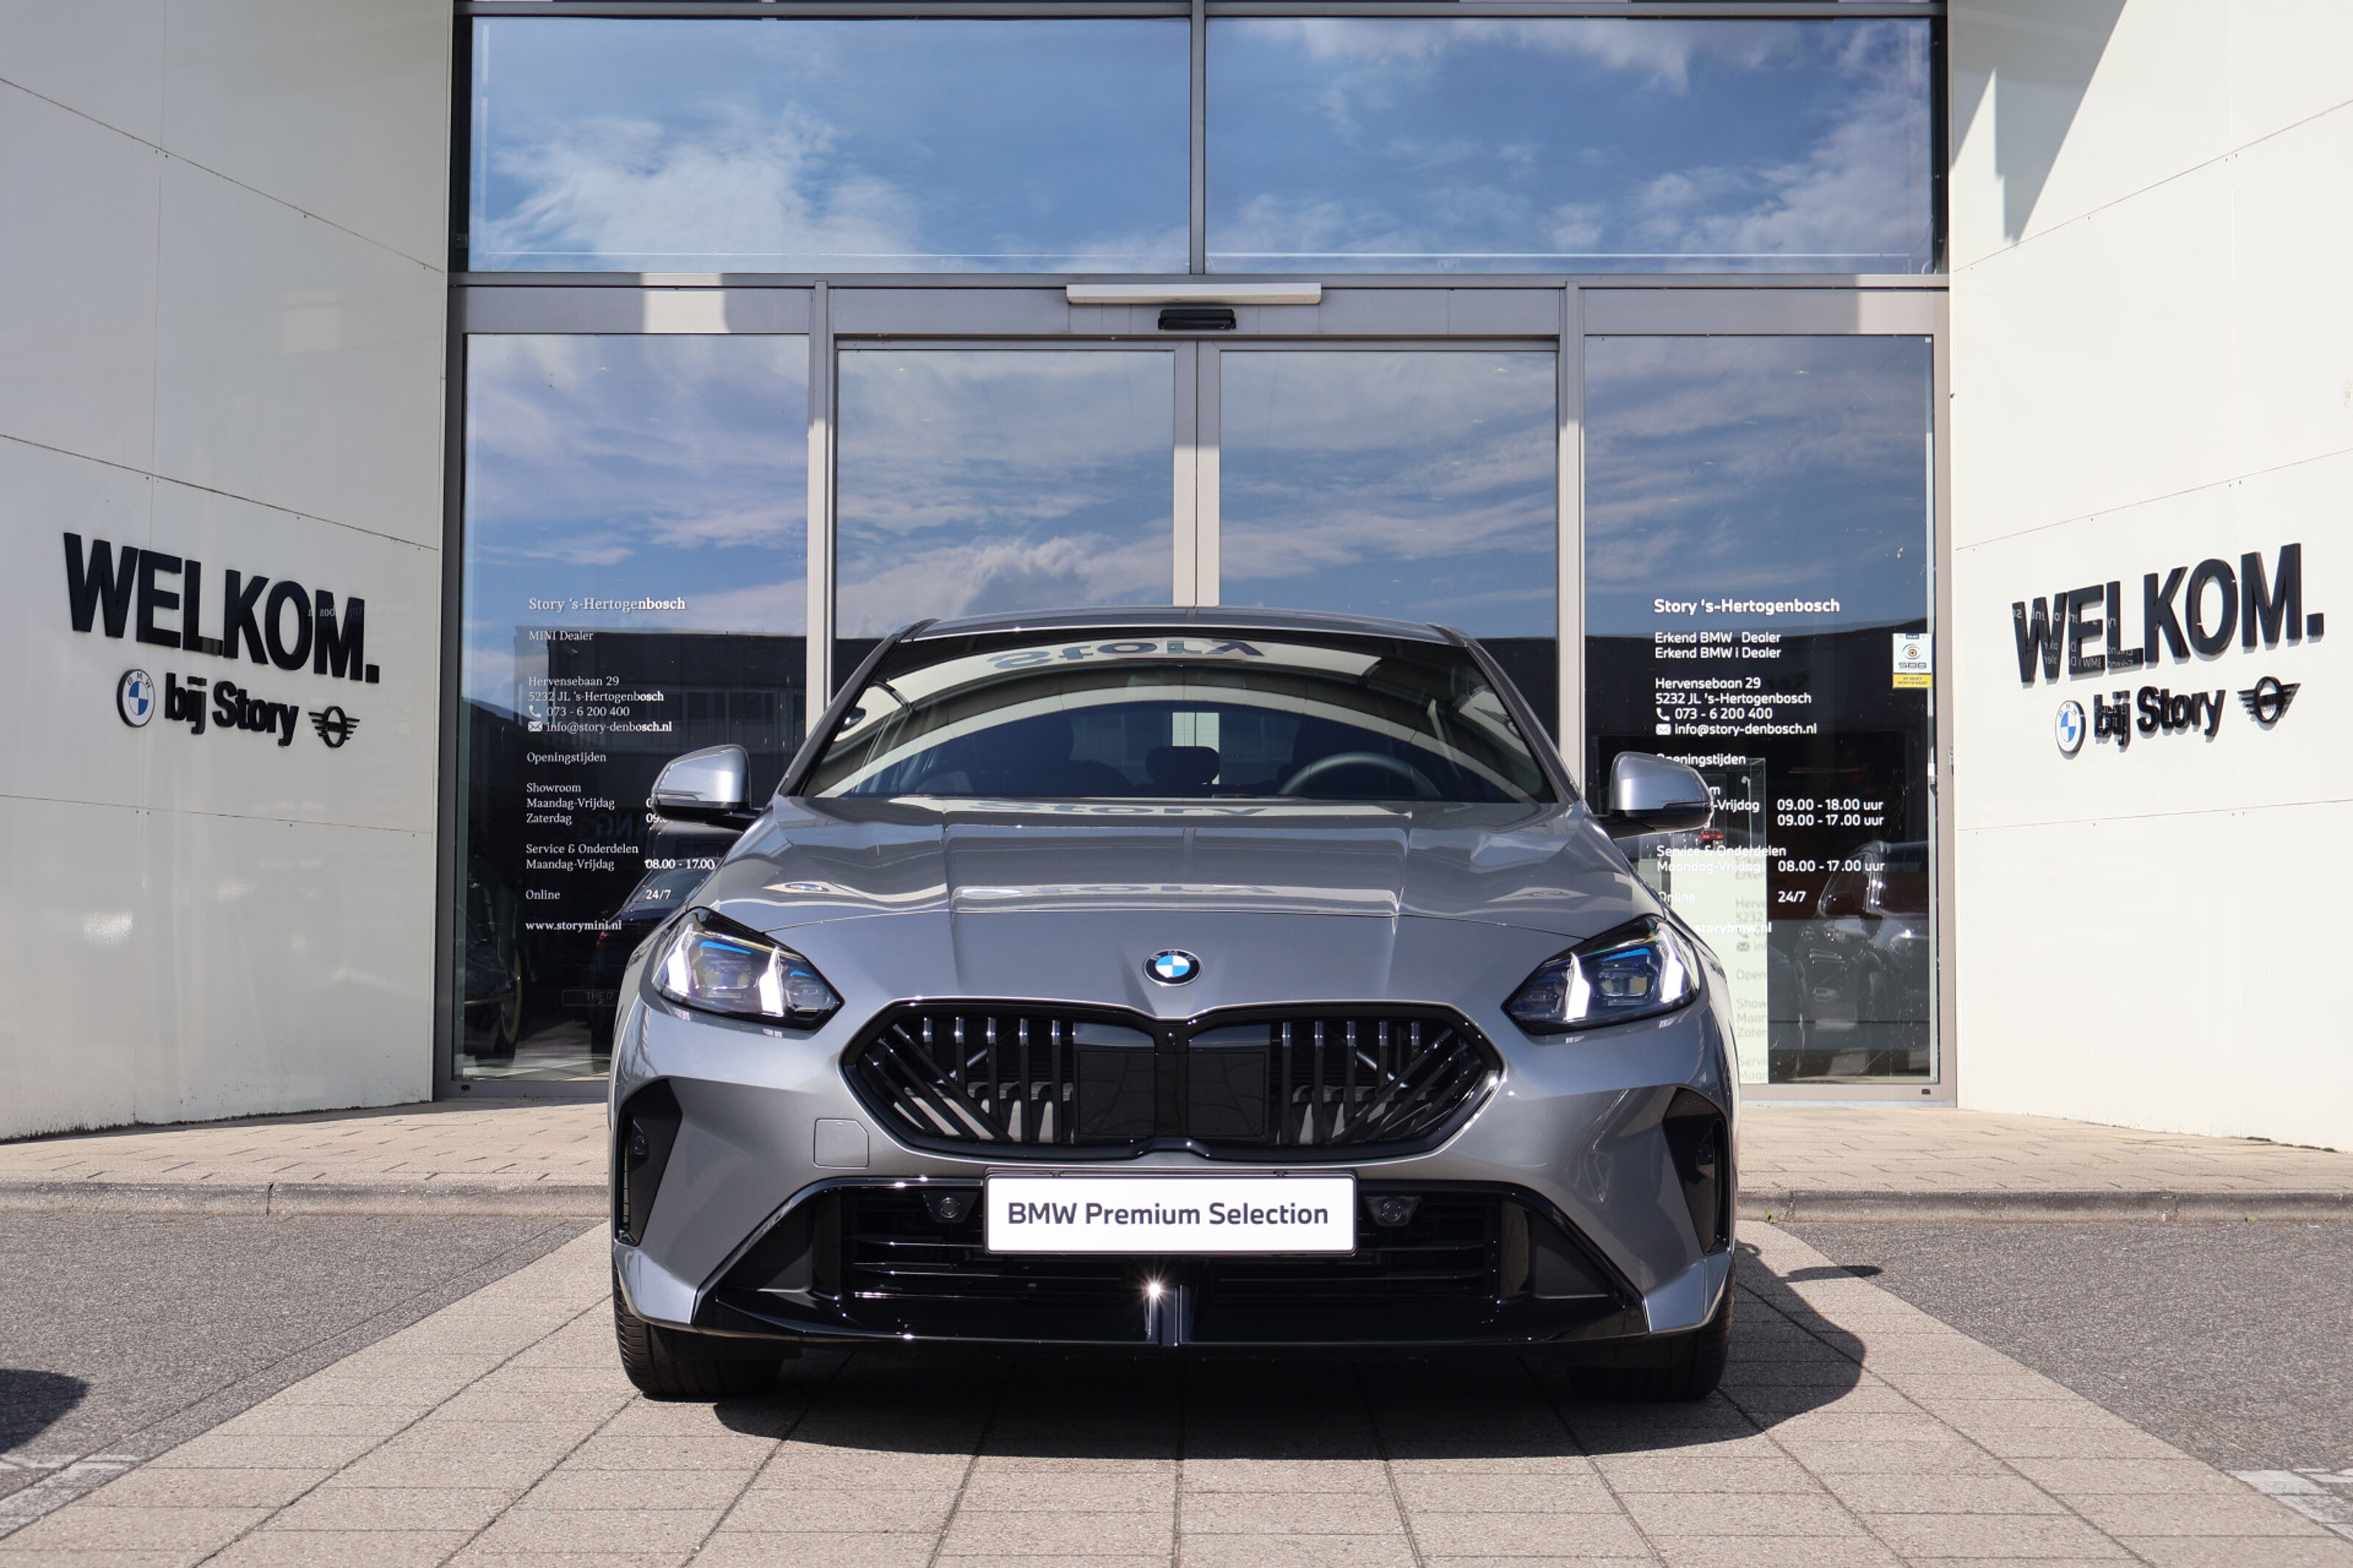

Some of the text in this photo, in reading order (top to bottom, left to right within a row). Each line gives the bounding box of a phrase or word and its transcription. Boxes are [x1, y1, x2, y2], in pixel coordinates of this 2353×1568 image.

[63, 532, 379, 684] WELKOM.
[529, 597, 565, 613] Story
[1654, 599, 1698, 615] Story
[2012, 543, 2324, 684] WELKOM.
[529, 630, 594, 641] MINI Dealer
[1654, 631, 1782, 644] Erkend BMW Dealer
[1654, 647, 1782, 659] Erkend BMW i Dealer
[529, 676, 620, 687] Hervensebaan 29
[1654, 678, 1762, 690] Hervensebaan 29
[529, 692, 556, 702] 5232
[557, 692, 571, 703] JL
[1655, 692, 1685, 704] 5232
[1687, 692, 1702, 705] JL
[165, 673, 299, 747] bij Story
[546, 706, 567, 717] 073
[576, 706, 584, 717] 6
[586, 706, 607, 717] 200
[610, 706, 631, 717] 400
[1674, 708, 1698, 720] 073
[1709, 708, 1718, 720] 6
[1720, 708, 1745, 720] 200
[1748, 708, 1774, 720] 400
[2093, 686, 2227, 746] bij Story
[546, 721, 673, 734] info@story-denbosch.nl
[1674, 723, 1817, 737] info@story-denbosch.nl
[526, 752, 607, 765] Openingstijden
[526, 782, 582, 793] Showroom
[526, 798, 615, 810] Maandag-Vrijdag
[1713, 799, 1760, 812] -Vrijdag
[1777, 799, 1815, 811] 09.00
[1825, 799, 1860, 811] 18.00
[1863, 801, 1883, 811] uur
[526, 812, 573, 826] Zaterdag
[1777, 815, 1815, 826] 09.00
[1825, 815, 1860, 826] 17.00
[1863, 817, 1884, 826] uur
[526, 843, 639, 854] Service & Onderdelen
[1657, 845, 1787, 857] Service & Onderdelen
[526, 859, 615, 871] Maandag-Vrijdag
[645, 859, 676, 870] 08.00
[686, 859, 715, 870] 17.00
[1657, 860, 1761, 873] Maandag-Vrijdag
[1778, 860, 1816, 873] 08.00
[1827, 860, 1862, 872] 17.00
[1865, 862, 1885, 872] uur
[526, 889, 671, 901] Online 24/7
[1778, 890, 1806, 903] 24/7
[526, 920, 622, 933] www.storymini.nl
[1694, 921, 1773, 935] storybmw.nl
[1007, 1202, 1329, 1225] BMW Premium Selection
